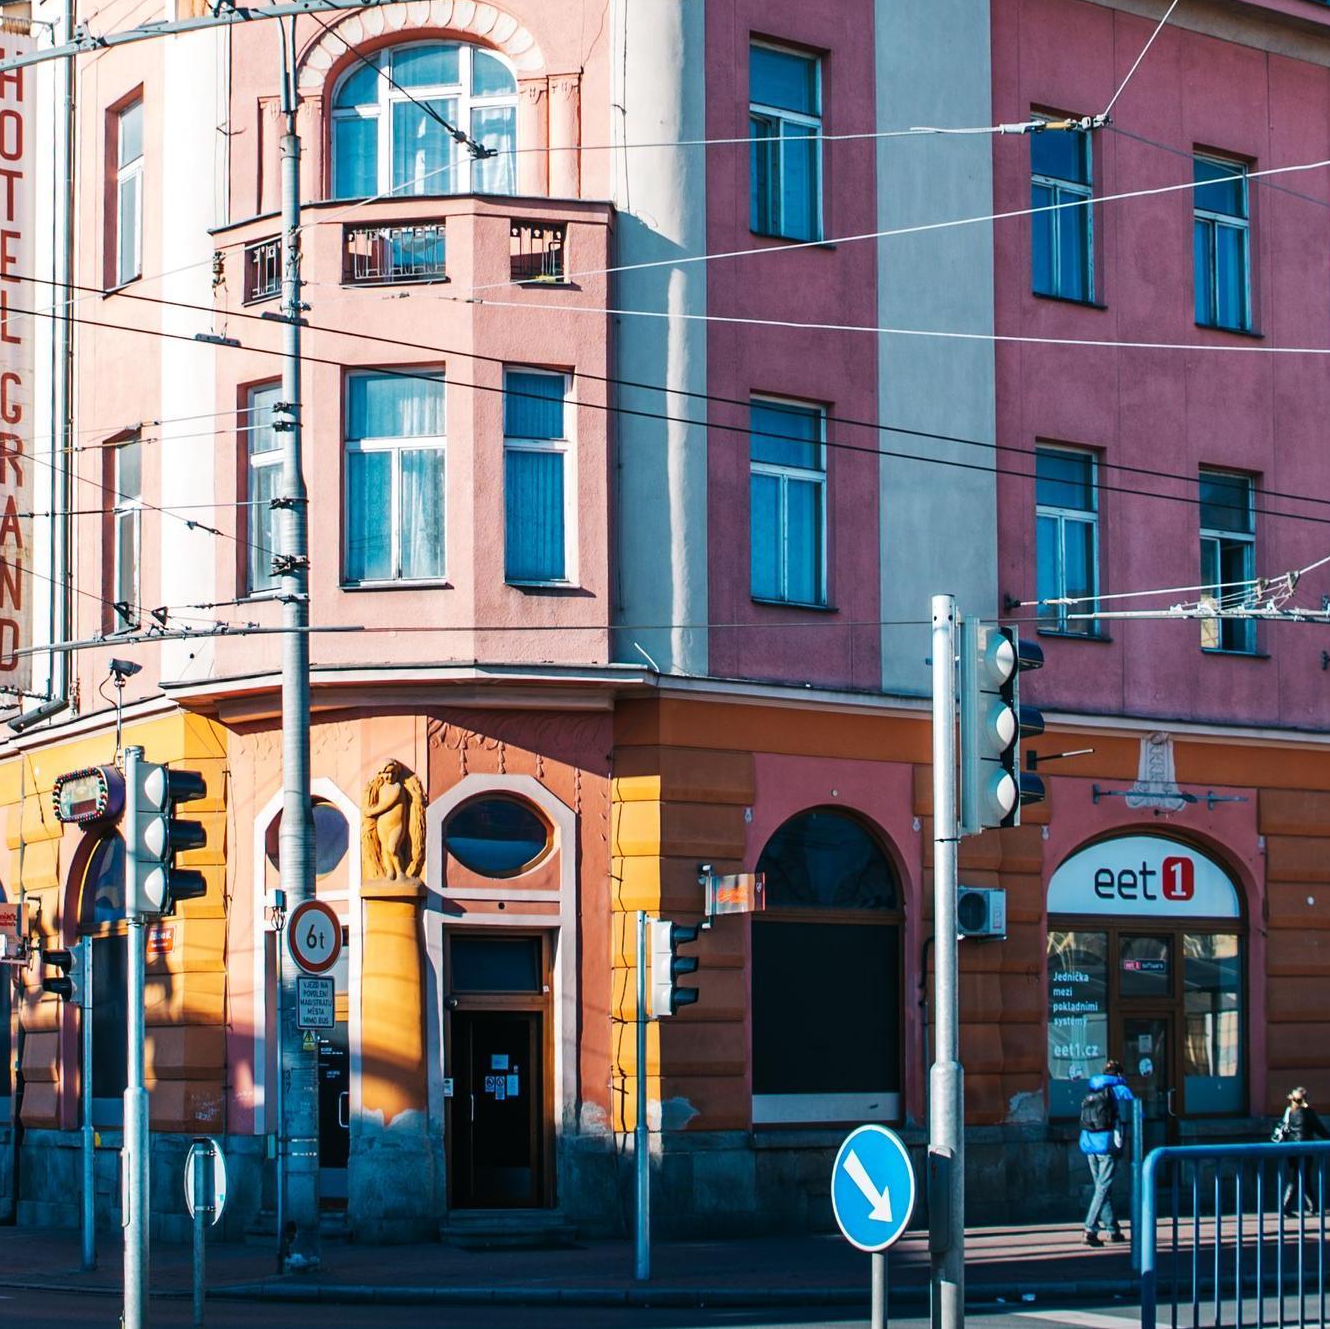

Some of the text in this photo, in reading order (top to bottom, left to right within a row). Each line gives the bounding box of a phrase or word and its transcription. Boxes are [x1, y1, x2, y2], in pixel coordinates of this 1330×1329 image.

[1094, 861, 1187, 901] eet 1
[1053, 971, 1089, 982] Jednička
[1053, 986, 1073, 996] mezi
[1053, 1001, 1098, 1013] pokladními
[1053, 1017, 1087, 1027] systémy
[1054, 1043, 1099, 1057] eet1.cz
